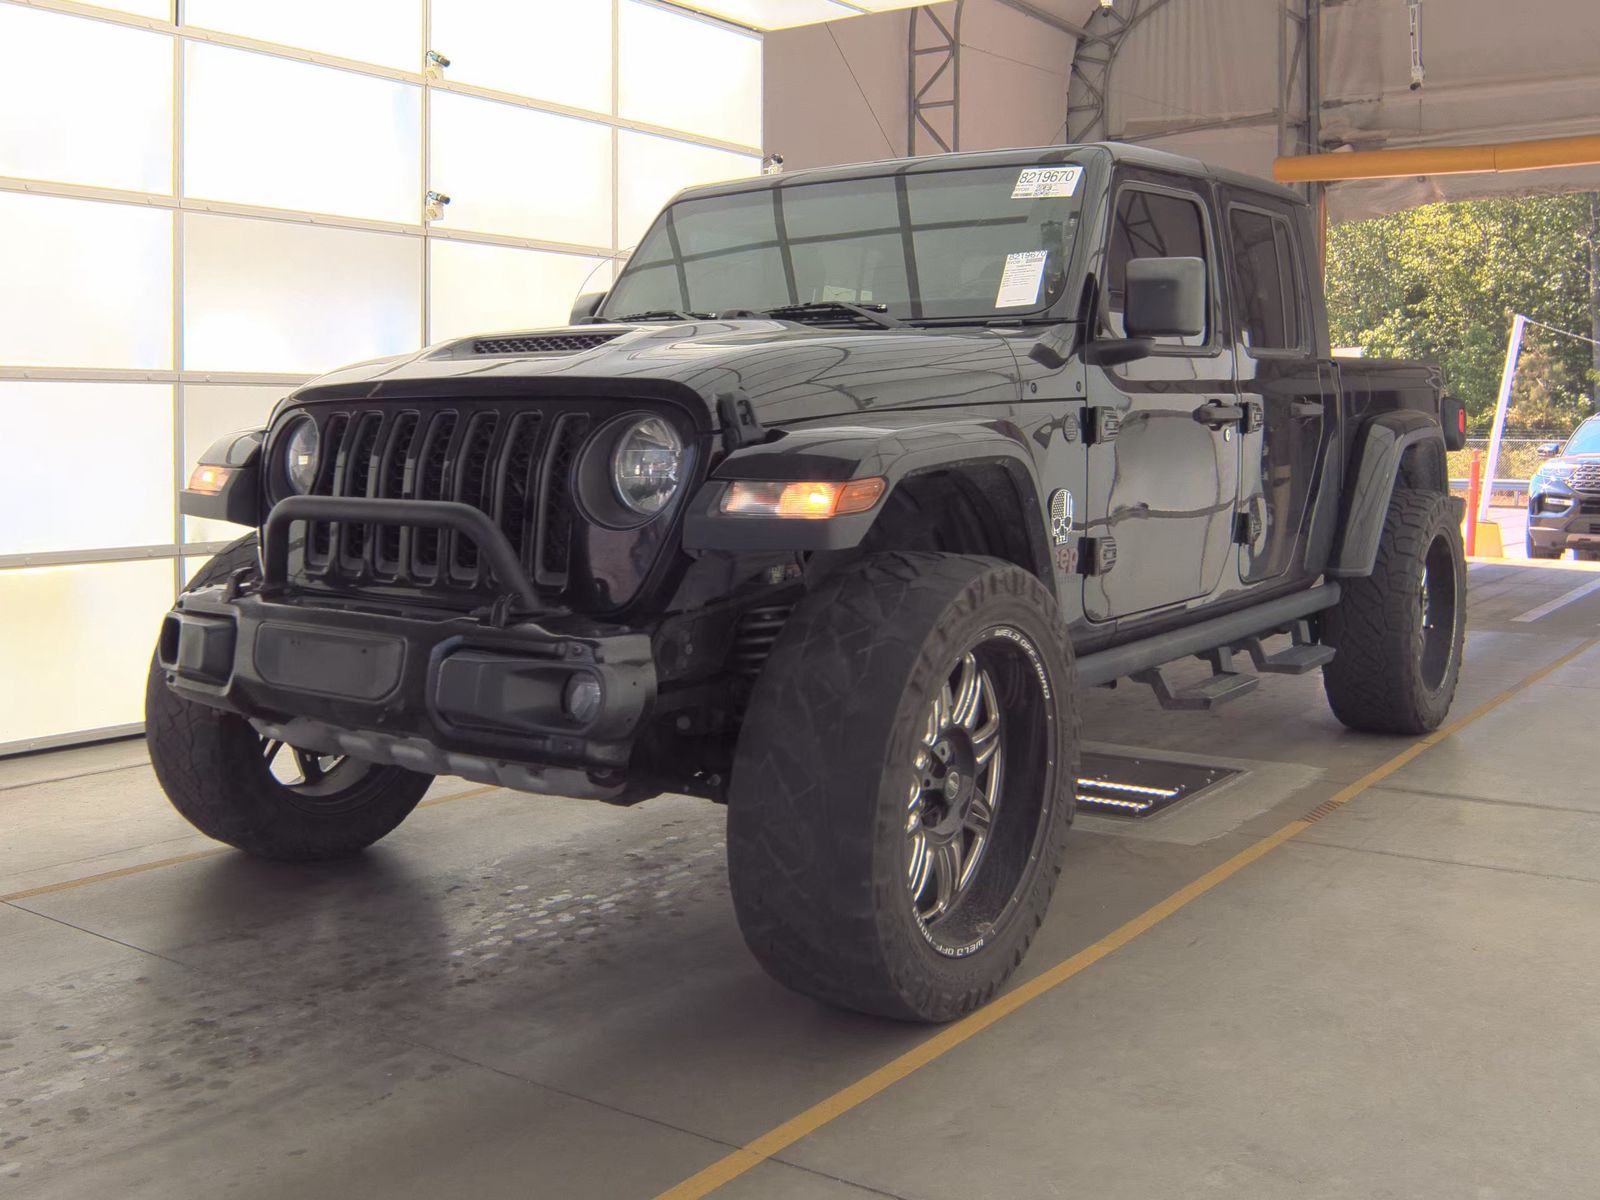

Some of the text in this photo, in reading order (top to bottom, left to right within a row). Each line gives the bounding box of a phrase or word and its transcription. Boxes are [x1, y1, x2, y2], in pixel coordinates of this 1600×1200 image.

[1019, 170, 1075, 184] 8219670
[994, 629, 1020, 641] WELD
[957, 938, 984, 956] WELD
